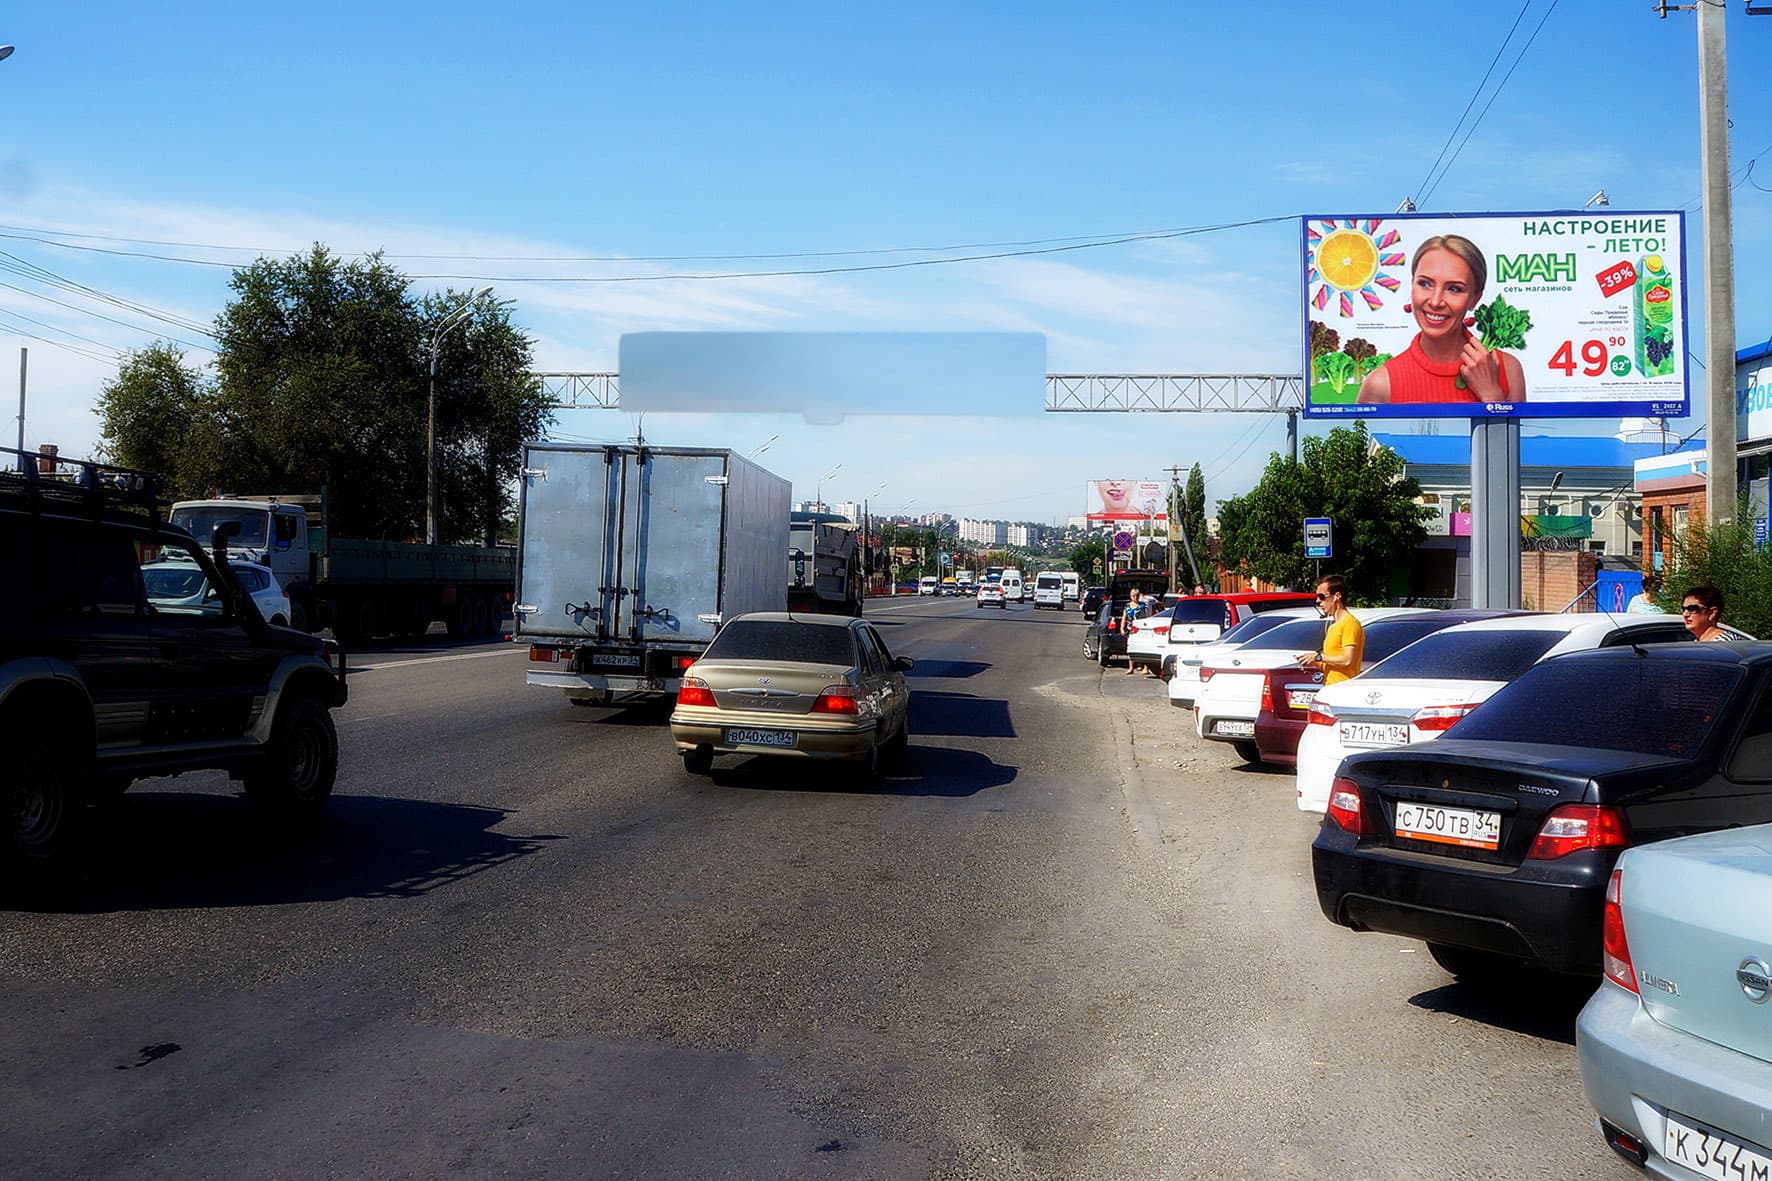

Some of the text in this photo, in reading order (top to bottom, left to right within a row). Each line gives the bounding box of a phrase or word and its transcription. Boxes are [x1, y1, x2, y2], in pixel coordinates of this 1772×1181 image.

[1523, 219, 1666, 235] НАСТРОЕНИЕ
[1603, 238, 1667, 253] ЛЕТО!
[1496, 253, 1577, 283] МАН
[1600, 265, 1634, 289] -39%
[1548, 336, 1625, 377] 49 90
[731, 730, 792, 743] В040ХС 134
[1476, 812, 1493, 831] 34
